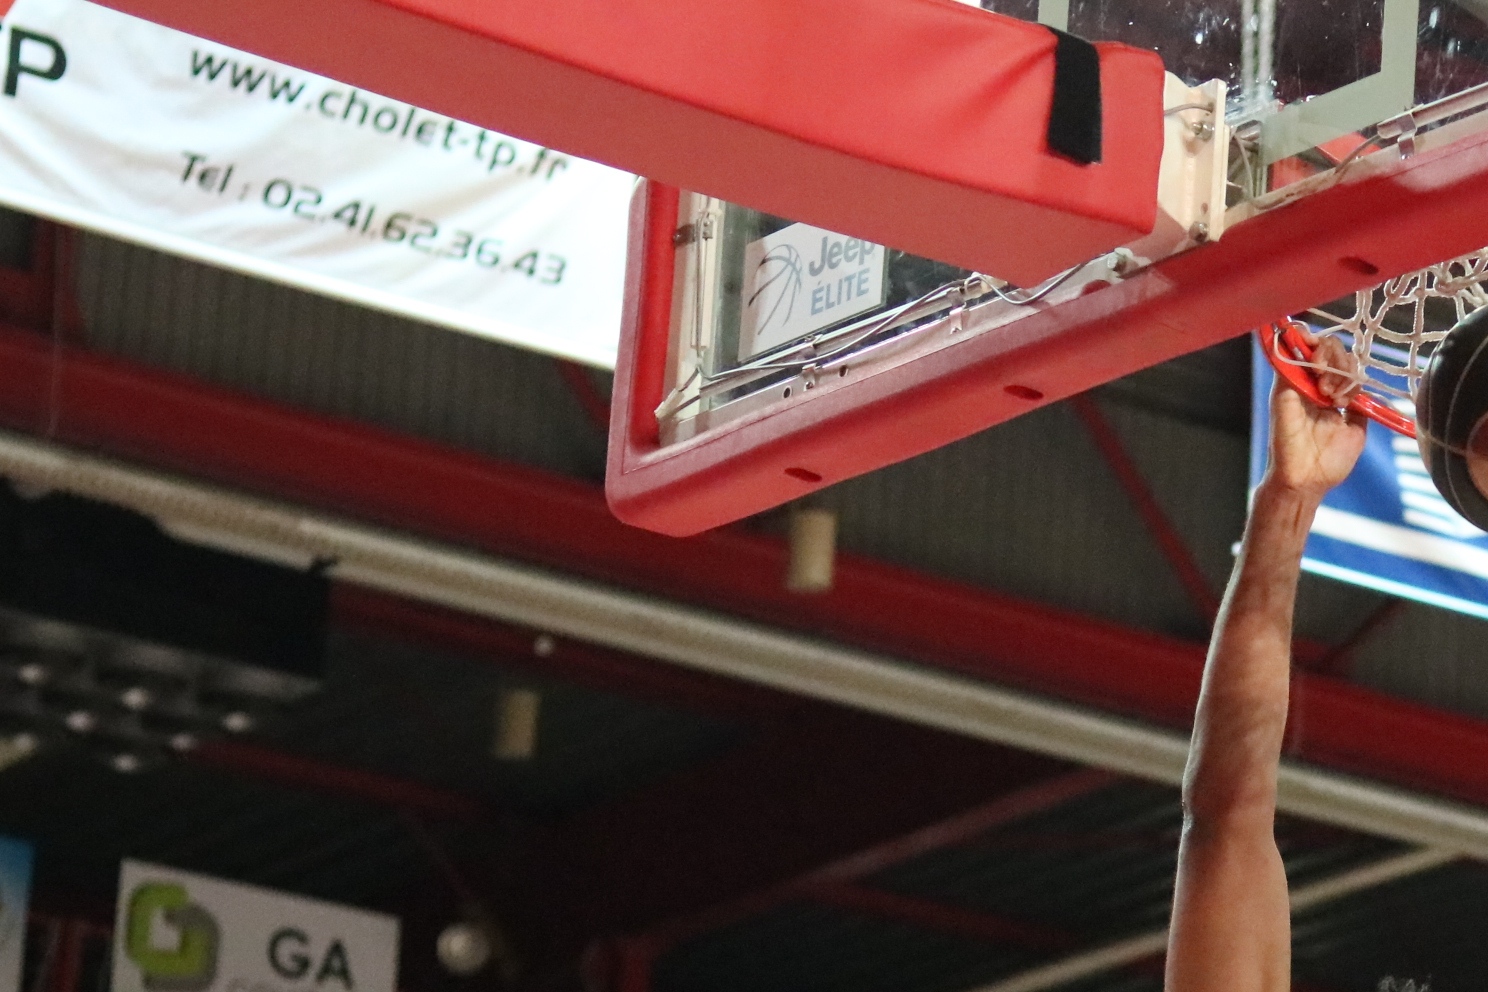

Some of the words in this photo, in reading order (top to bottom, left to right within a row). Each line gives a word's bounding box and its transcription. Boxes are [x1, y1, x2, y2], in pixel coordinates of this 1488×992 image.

[0, 24, 67, 98] P
[190, 48, 569, 182] www.cholet-tp.fr
[262, 177, 567, 286] 02.41.62.36.43
[808, 235, 875, 277] Jeep
[810, 267, 871, 316] ÉLITE
[269, 928, 354, 990] GA
